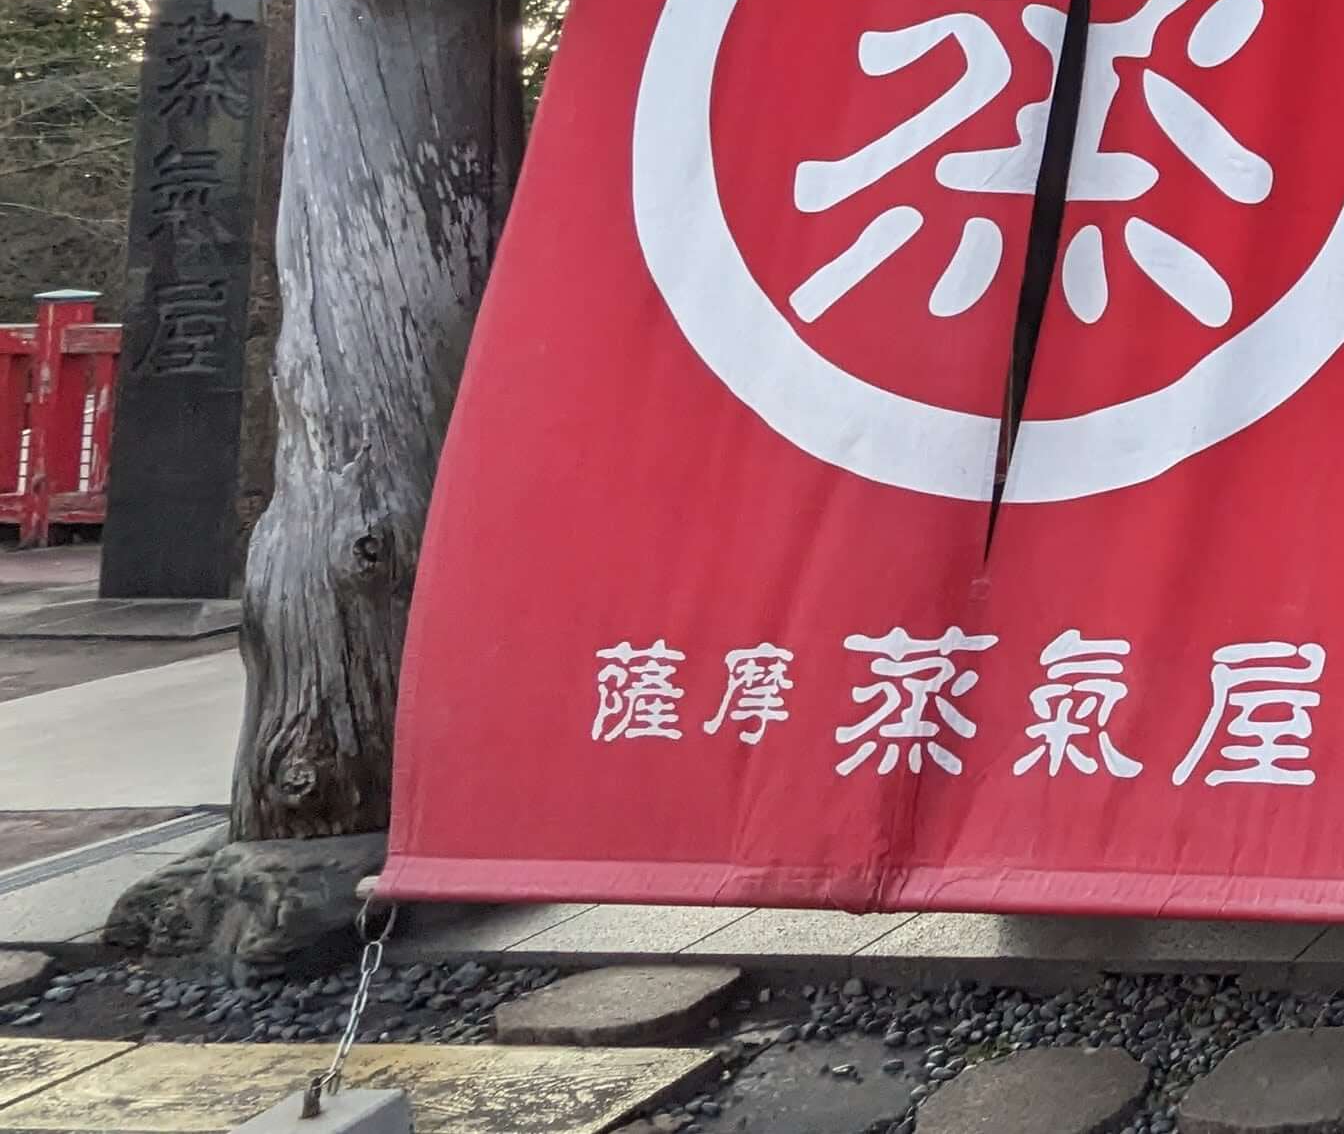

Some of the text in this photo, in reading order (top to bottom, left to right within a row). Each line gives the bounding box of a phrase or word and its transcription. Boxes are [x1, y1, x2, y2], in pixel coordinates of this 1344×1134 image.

[591, 626, 1326, 786] 薩摩蒸氣屋
